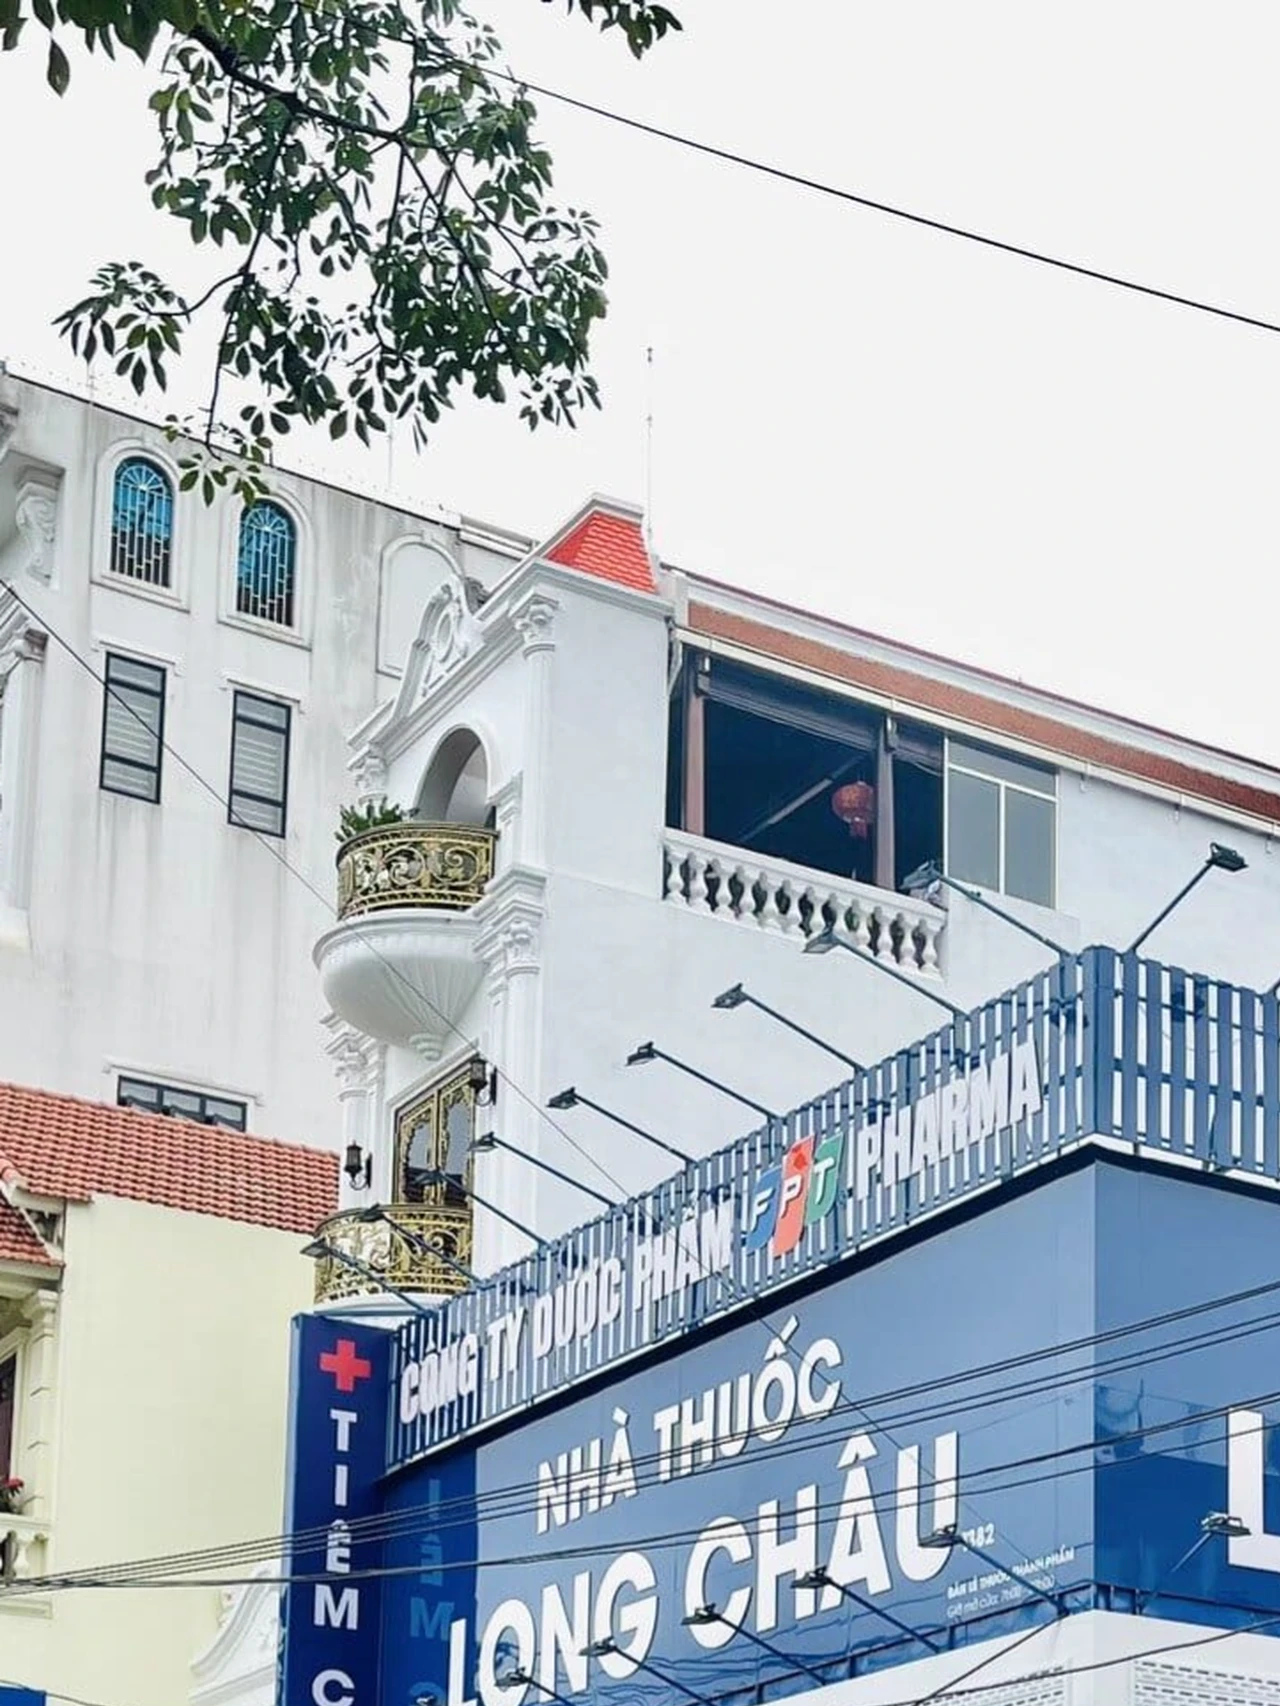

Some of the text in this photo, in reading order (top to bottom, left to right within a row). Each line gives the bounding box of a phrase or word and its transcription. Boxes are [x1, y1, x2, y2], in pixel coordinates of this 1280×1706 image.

[400, 1041, 1042, 1424] CÔNG TY DƯỢC PHẨM FPT PHARMA
[313, 1408, 359, 1630] TIÊM
[536, 1315, 842, 1536] NHÀ THUỐC
[684, 1430, 961, 1650] CHÂU
